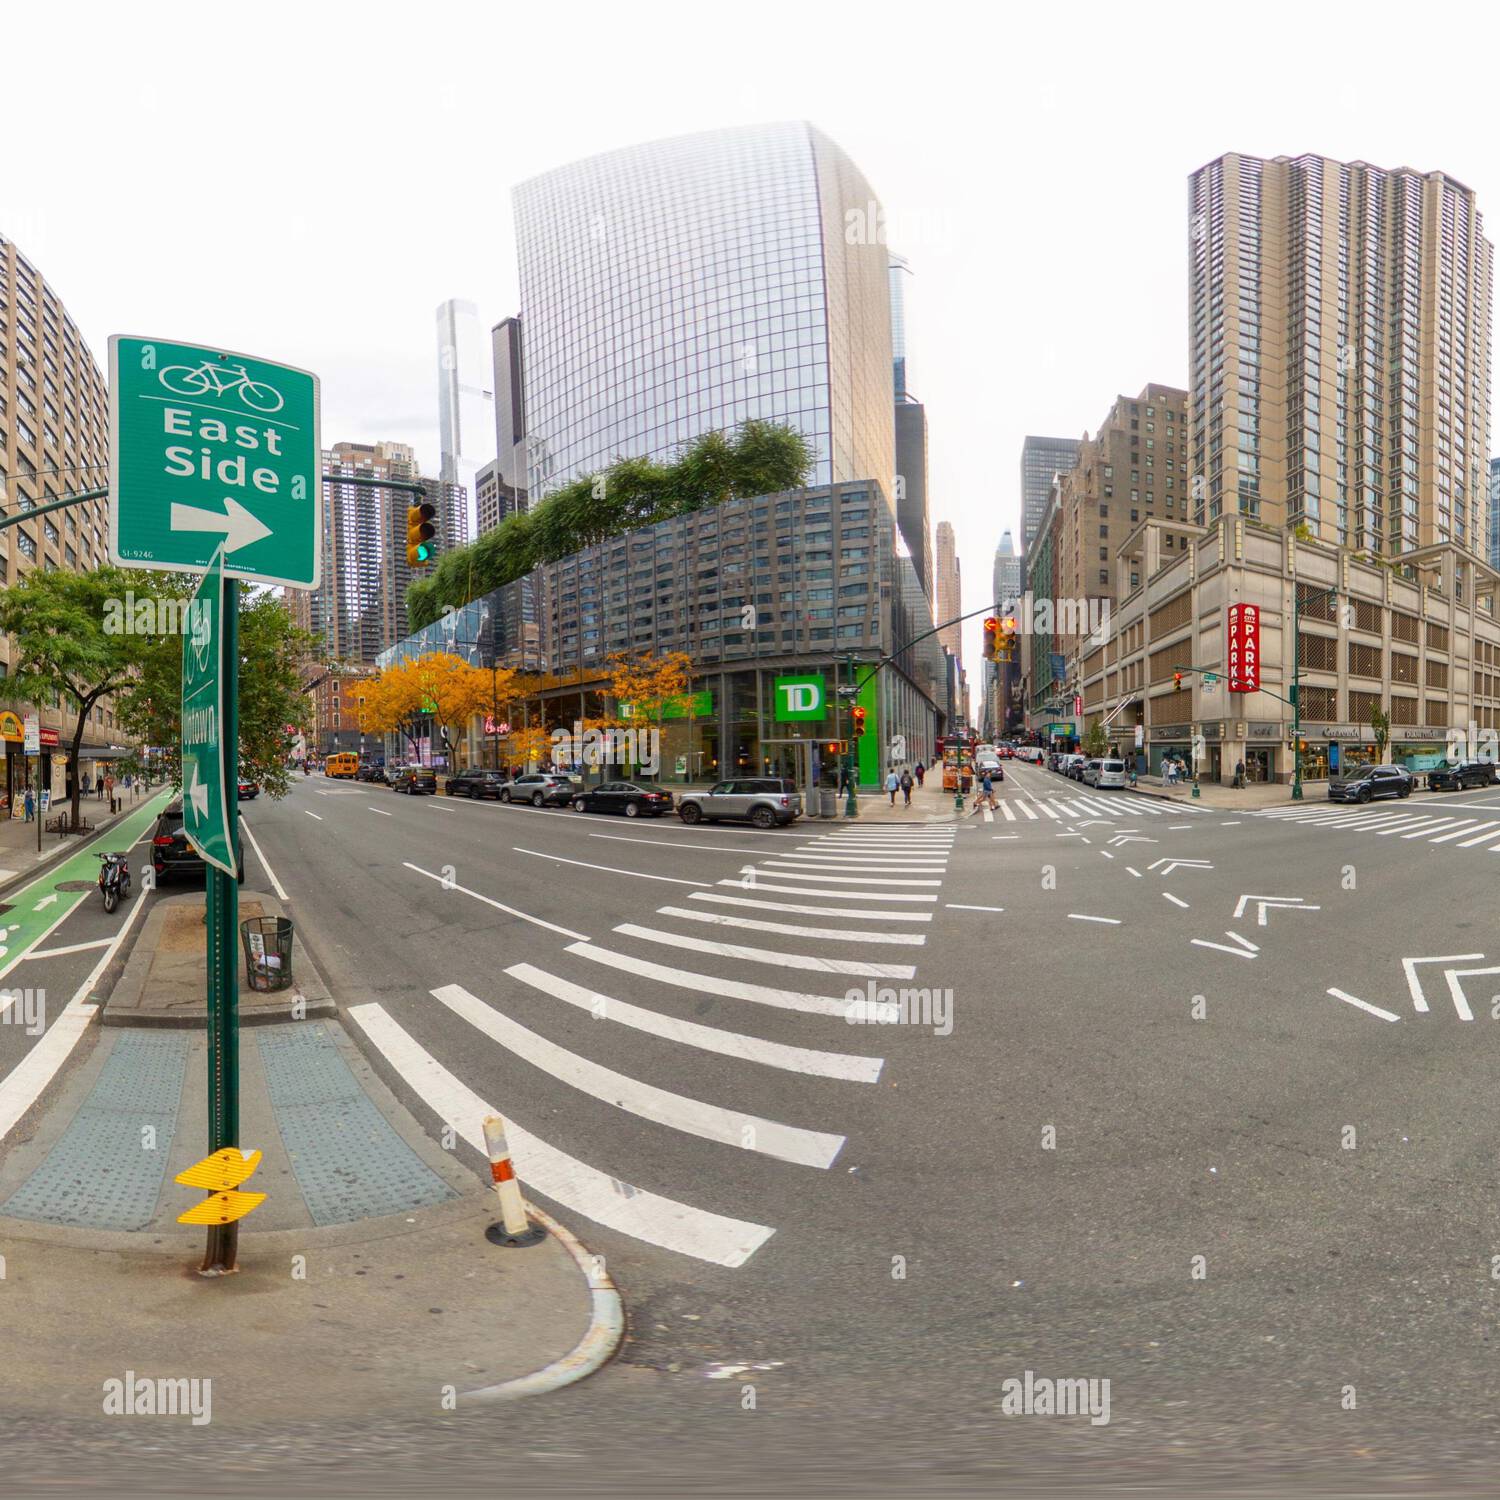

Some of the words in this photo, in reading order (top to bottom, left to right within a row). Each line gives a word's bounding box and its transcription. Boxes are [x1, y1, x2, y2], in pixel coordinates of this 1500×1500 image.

[164, 408, 282, 456] East
[164, 446, 280, 493] Side
[1230, 625, 1238, 678] PARK
[1244, 624, 1255, 678] PARK
[779, 683, 820, 712] TD
